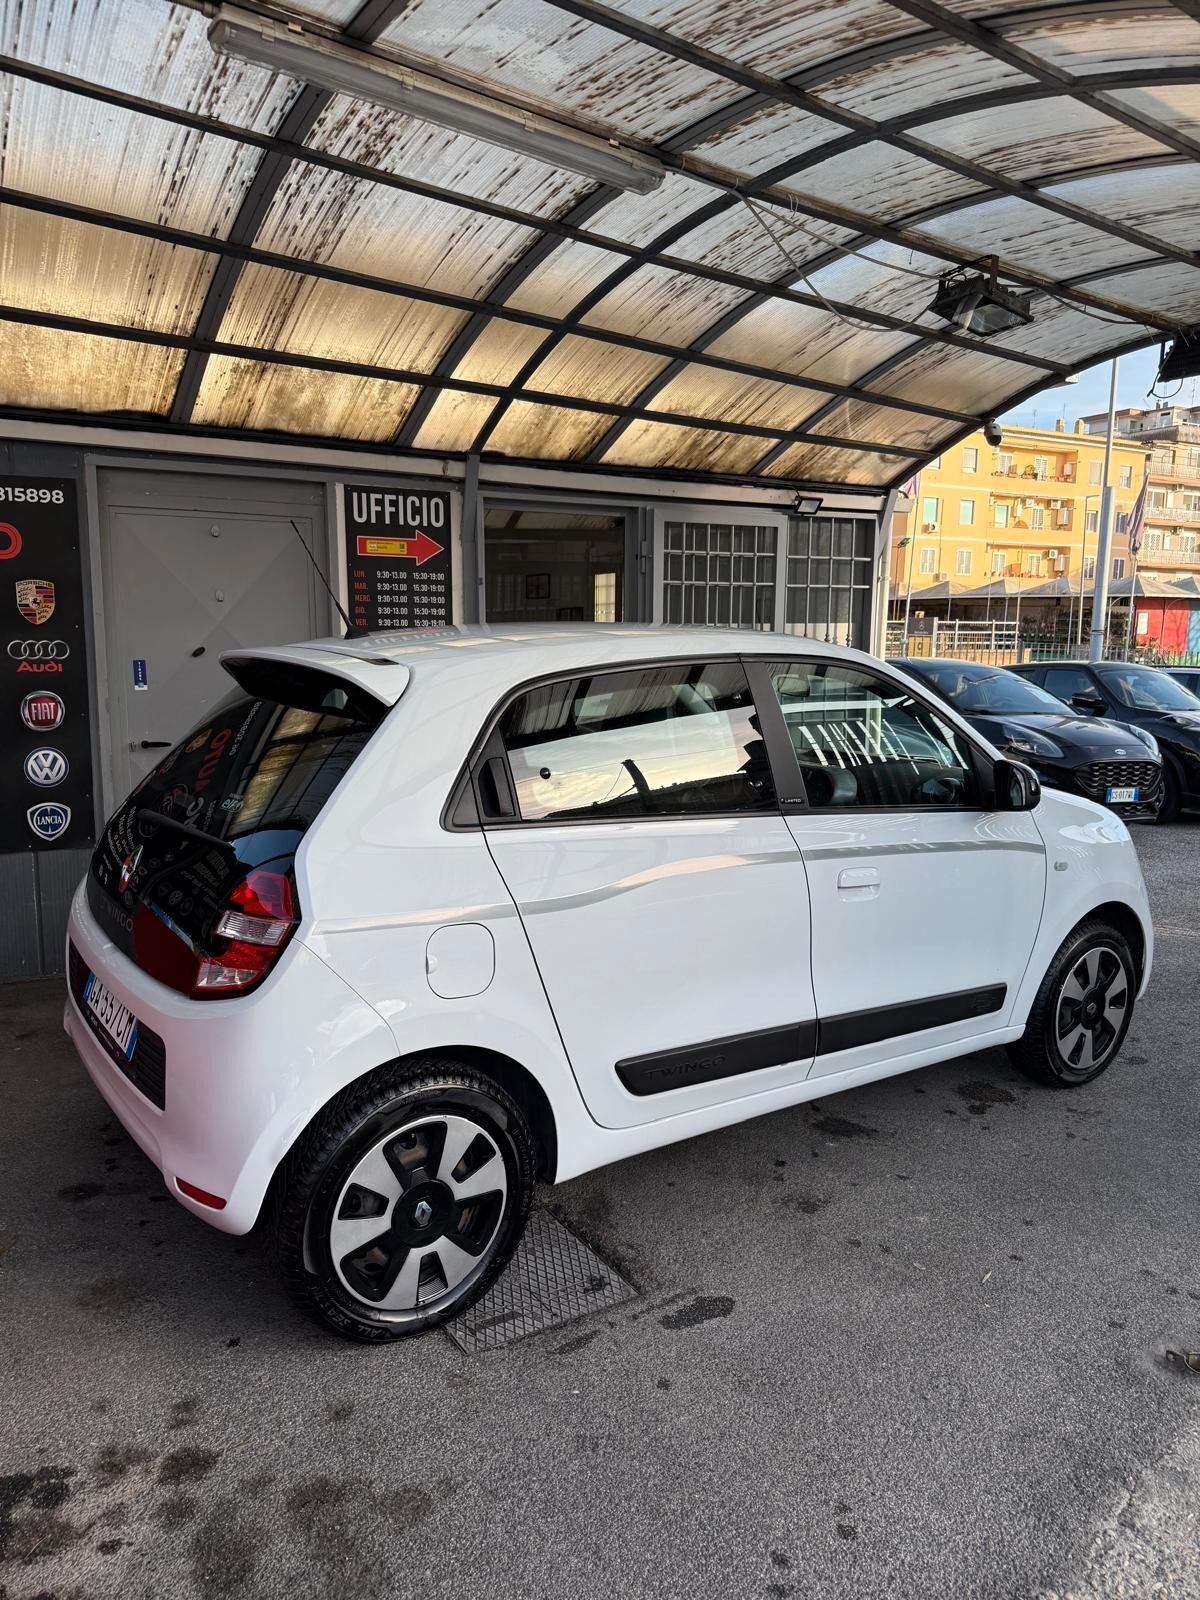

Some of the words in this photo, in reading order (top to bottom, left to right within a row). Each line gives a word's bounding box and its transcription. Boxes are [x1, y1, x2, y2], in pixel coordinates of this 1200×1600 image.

[352, 492, 444, 528] UFFICIO
[16, 661, 63, 673] Audi
[31, 702, 56, 721] FIAT
[37, 816, 62, 825] LANCIA
[645, 1054, 726, 1081] TWINGO
